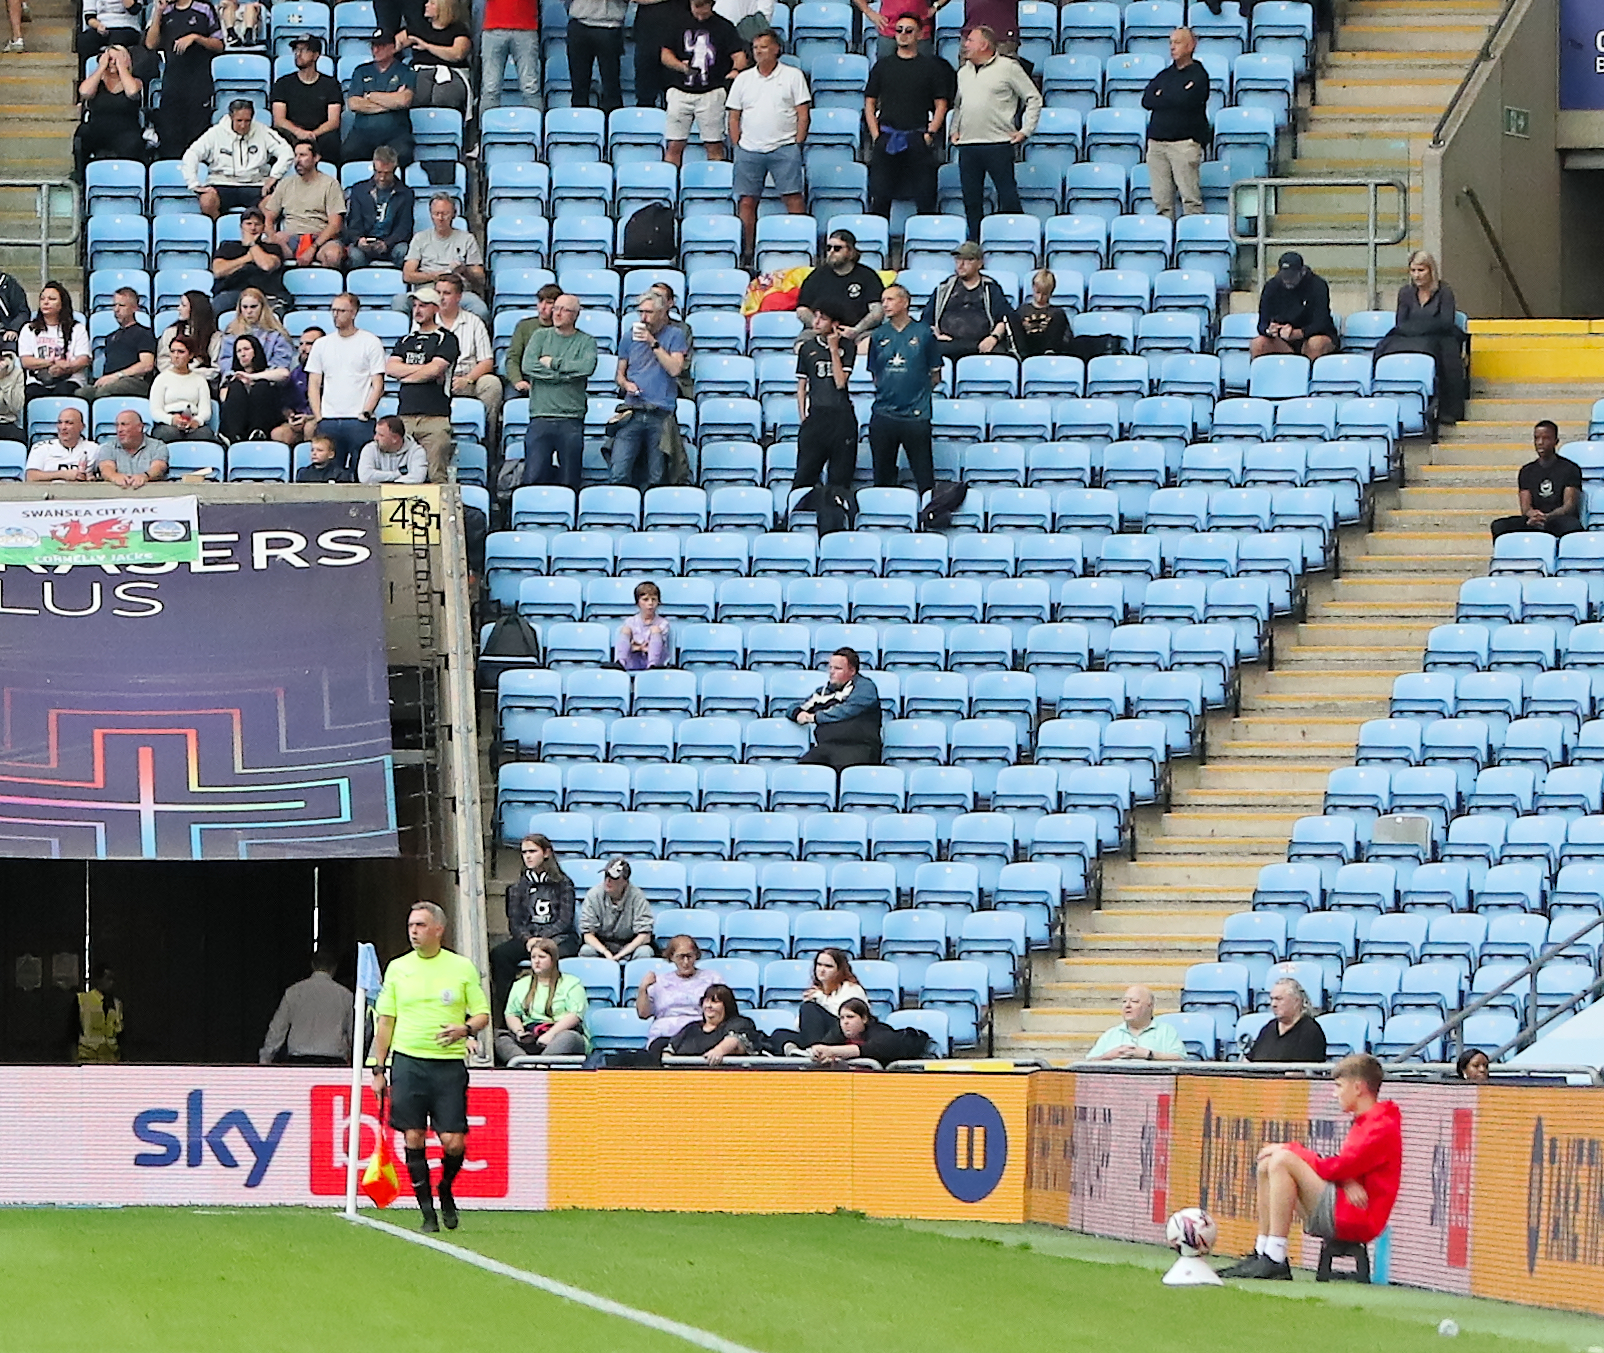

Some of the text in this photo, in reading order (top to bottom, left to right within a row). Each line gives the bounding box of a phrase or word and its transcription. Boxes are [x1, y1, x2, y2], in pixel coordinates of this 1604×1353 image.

[21, 506, 158, 518] SWANSEA CITY AFC
[33, 552, 155, 564] CORNELLY JACKS
[133, 1089, 293, 1188] sky
